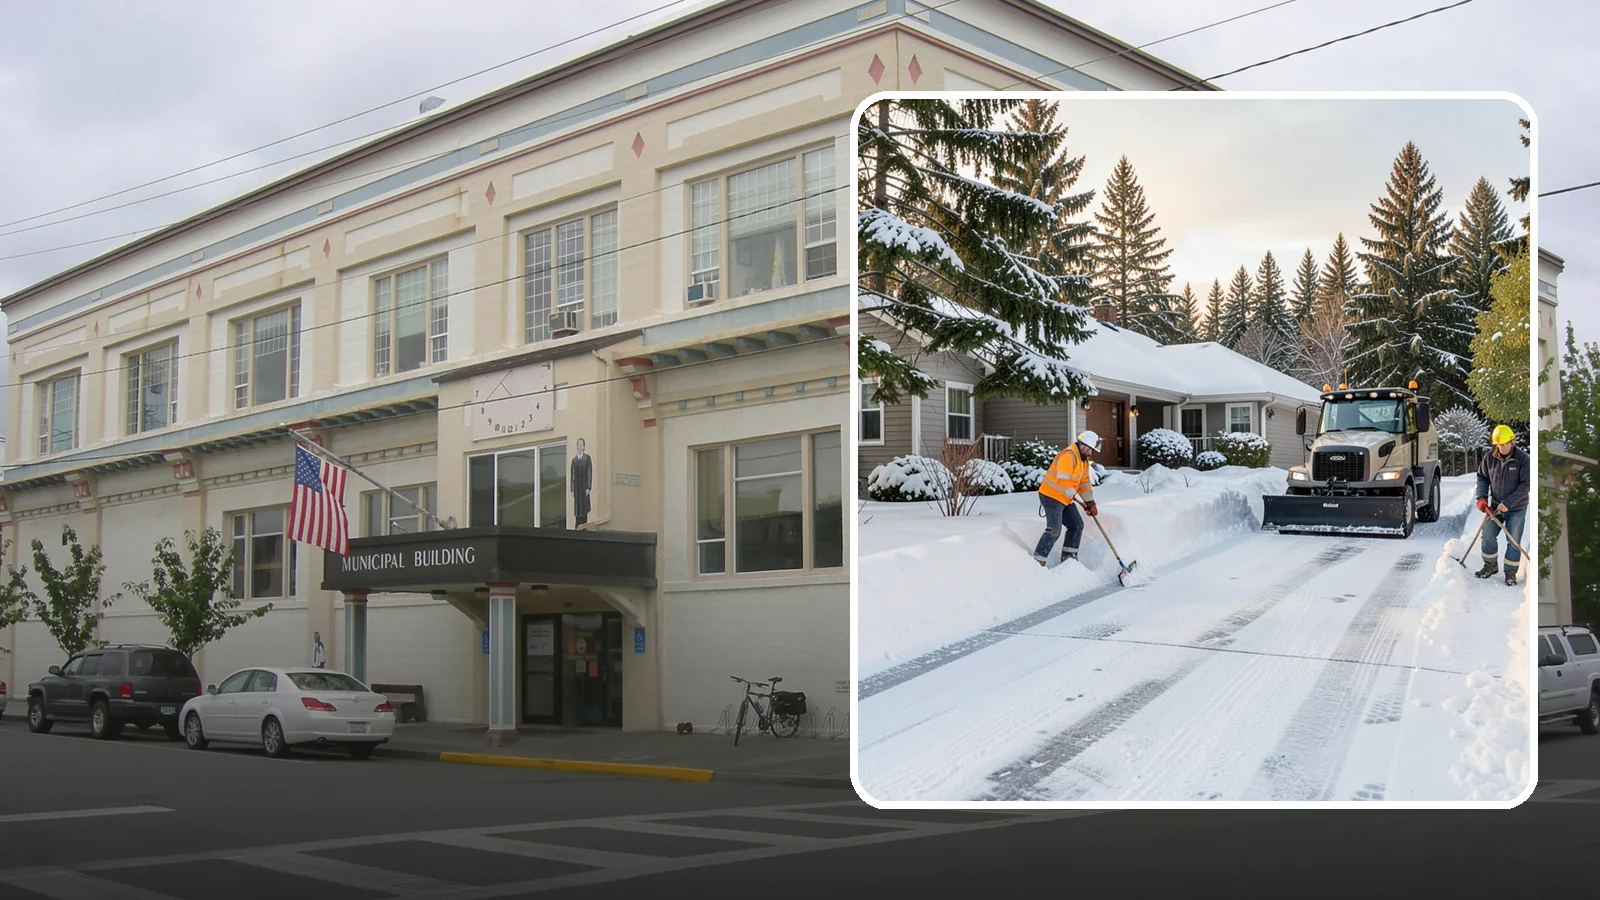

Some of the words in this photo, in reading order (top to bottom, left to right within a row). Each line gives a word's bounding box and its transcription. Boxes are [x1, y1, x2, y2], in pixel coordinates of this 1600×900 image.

[488, 418, 492, 426] 9
[342, 552, 405, 572] MUNICIPAL
[414, 546, 475, 567] BUILDING
